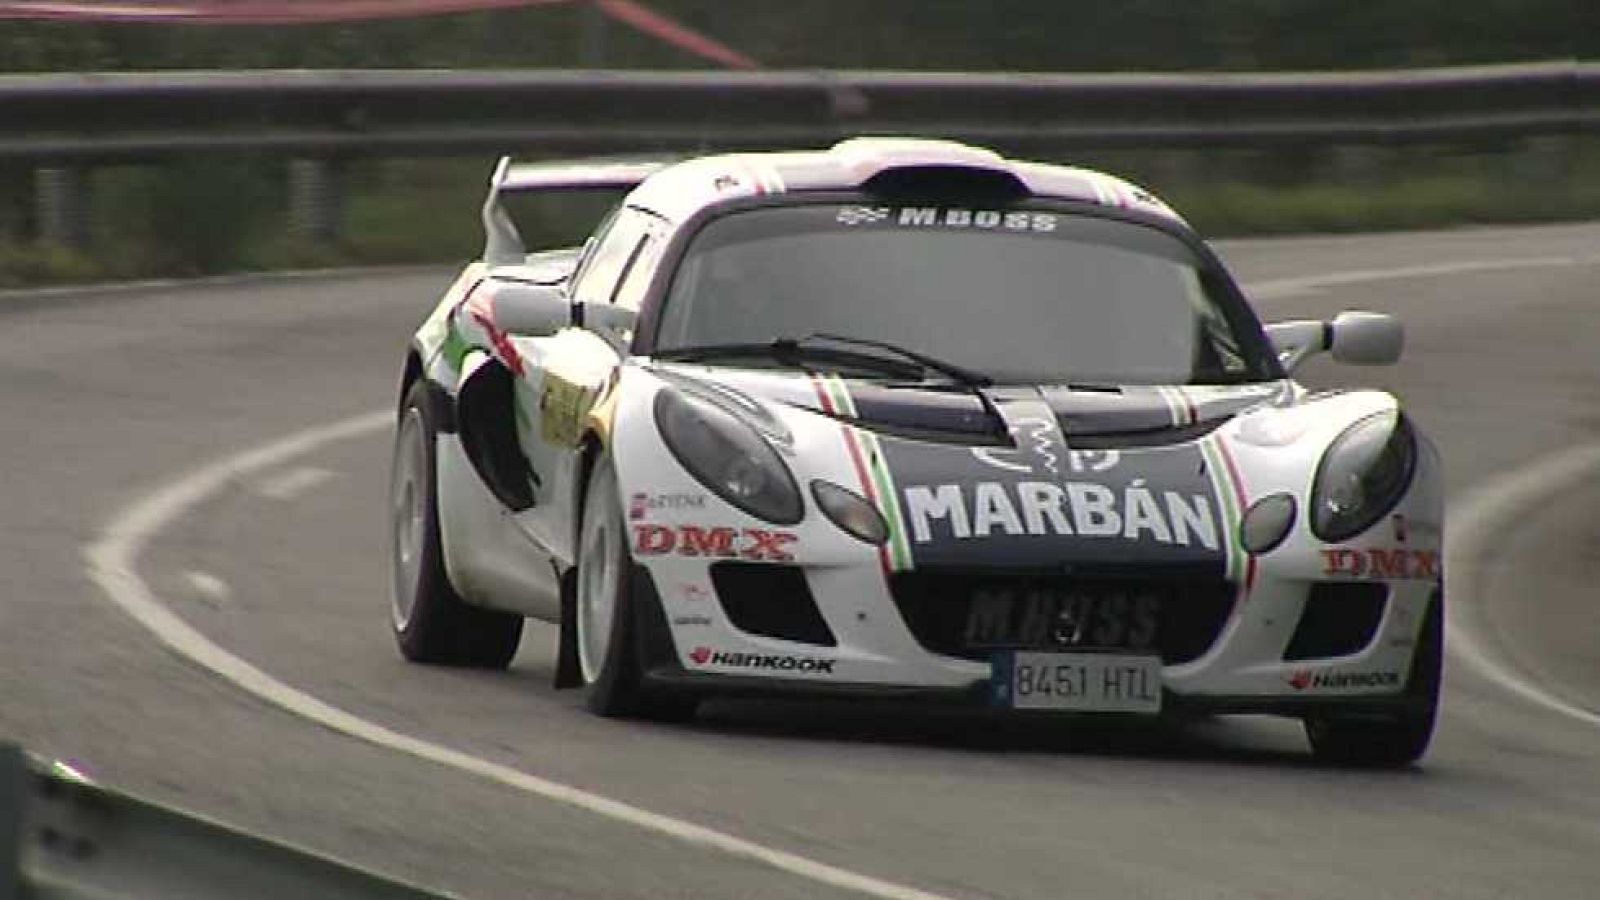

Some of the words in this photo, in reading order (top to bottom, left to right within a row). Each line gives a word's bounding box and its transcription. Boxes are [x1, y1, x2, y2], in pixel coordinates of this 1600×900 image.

[899, 206, 1058, 232] M.BOSS
[904, 479, 1219, 550] MARBÁN
[633, 524, 799, 561] DMX
[1319, 549, 1440, 579] DMX
[1016, 665, 1087, 697] 8451
[1103, 667, 1156, 700] HTL
